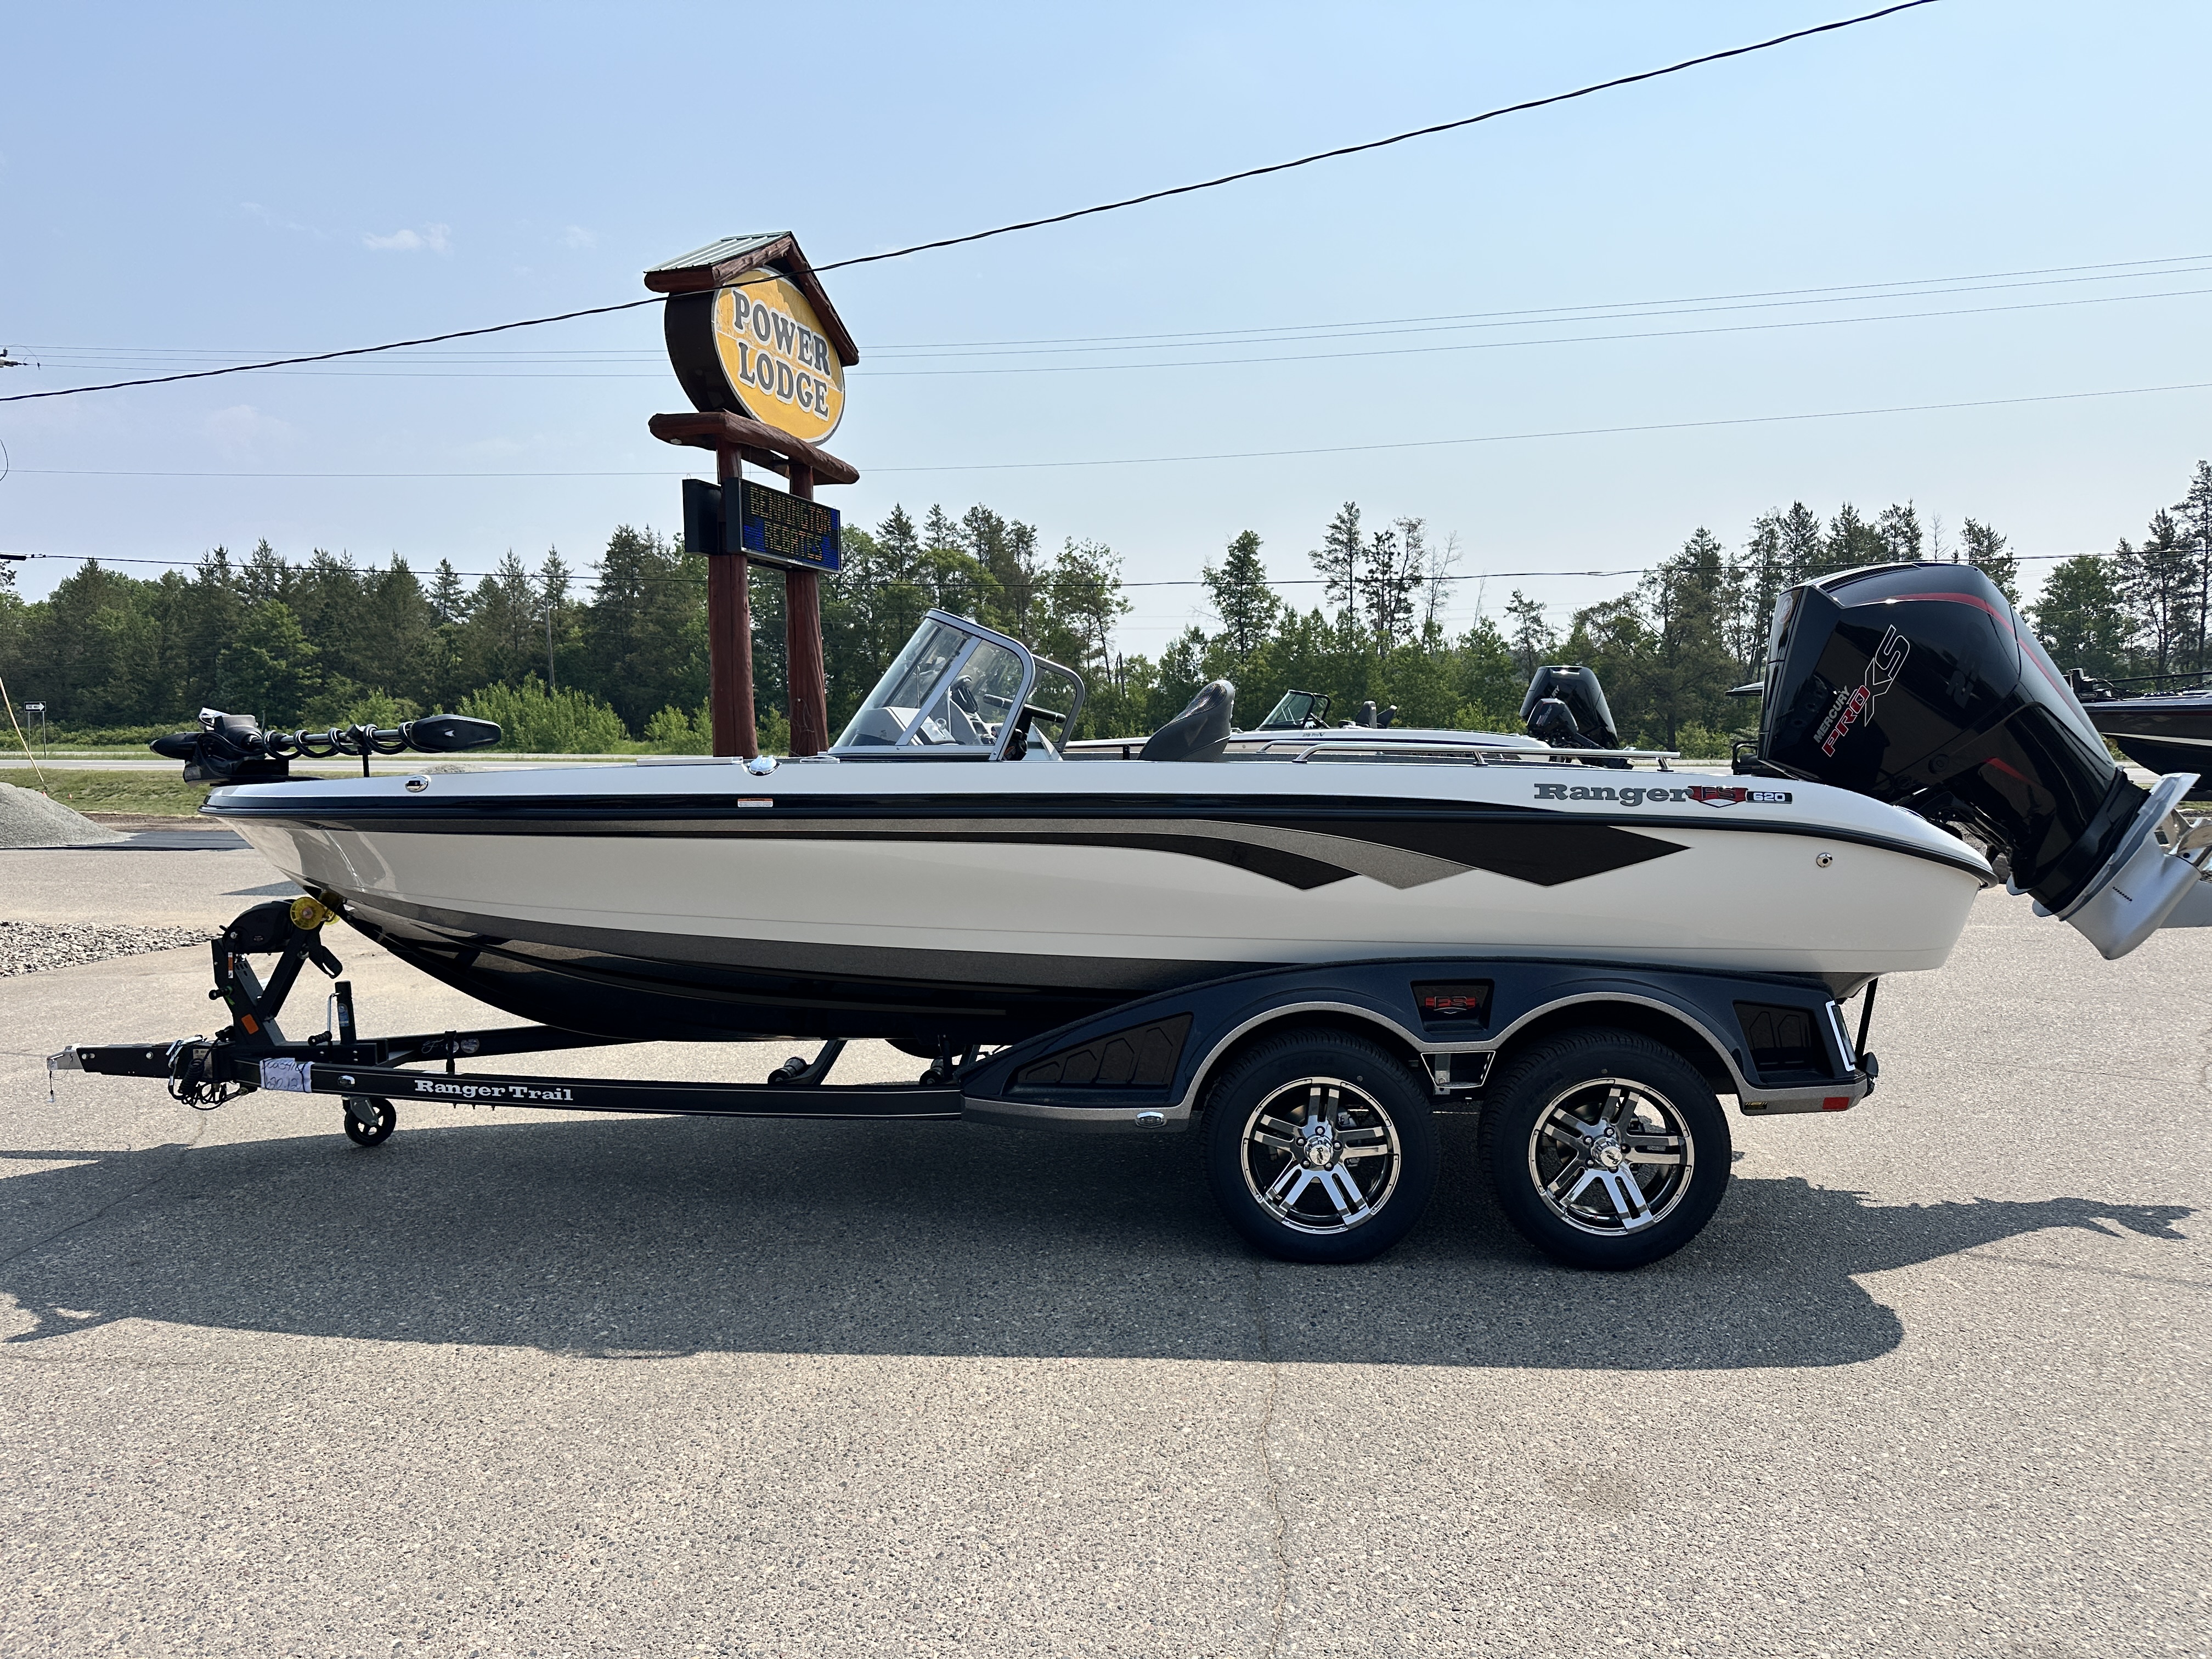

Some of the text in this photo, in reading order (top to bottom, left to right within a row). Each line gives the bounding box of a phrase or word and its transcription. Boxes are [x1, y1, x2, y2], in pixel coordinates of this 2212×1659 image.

[732, 289, 831, 376] POWER
[738, 341, 829, 418] LODGE
[750, 486, 832, 537] BENNINGTON
[1813, 685, 1850, 743] MERCURY
[1821, 624, 1910, 758] PRO XS
[1534, 783, 1786, 806] Ranger FS 620
[1434, 996, 1468, 1009] FS
[414, 1080, 574, 1101] Ranger Trail
